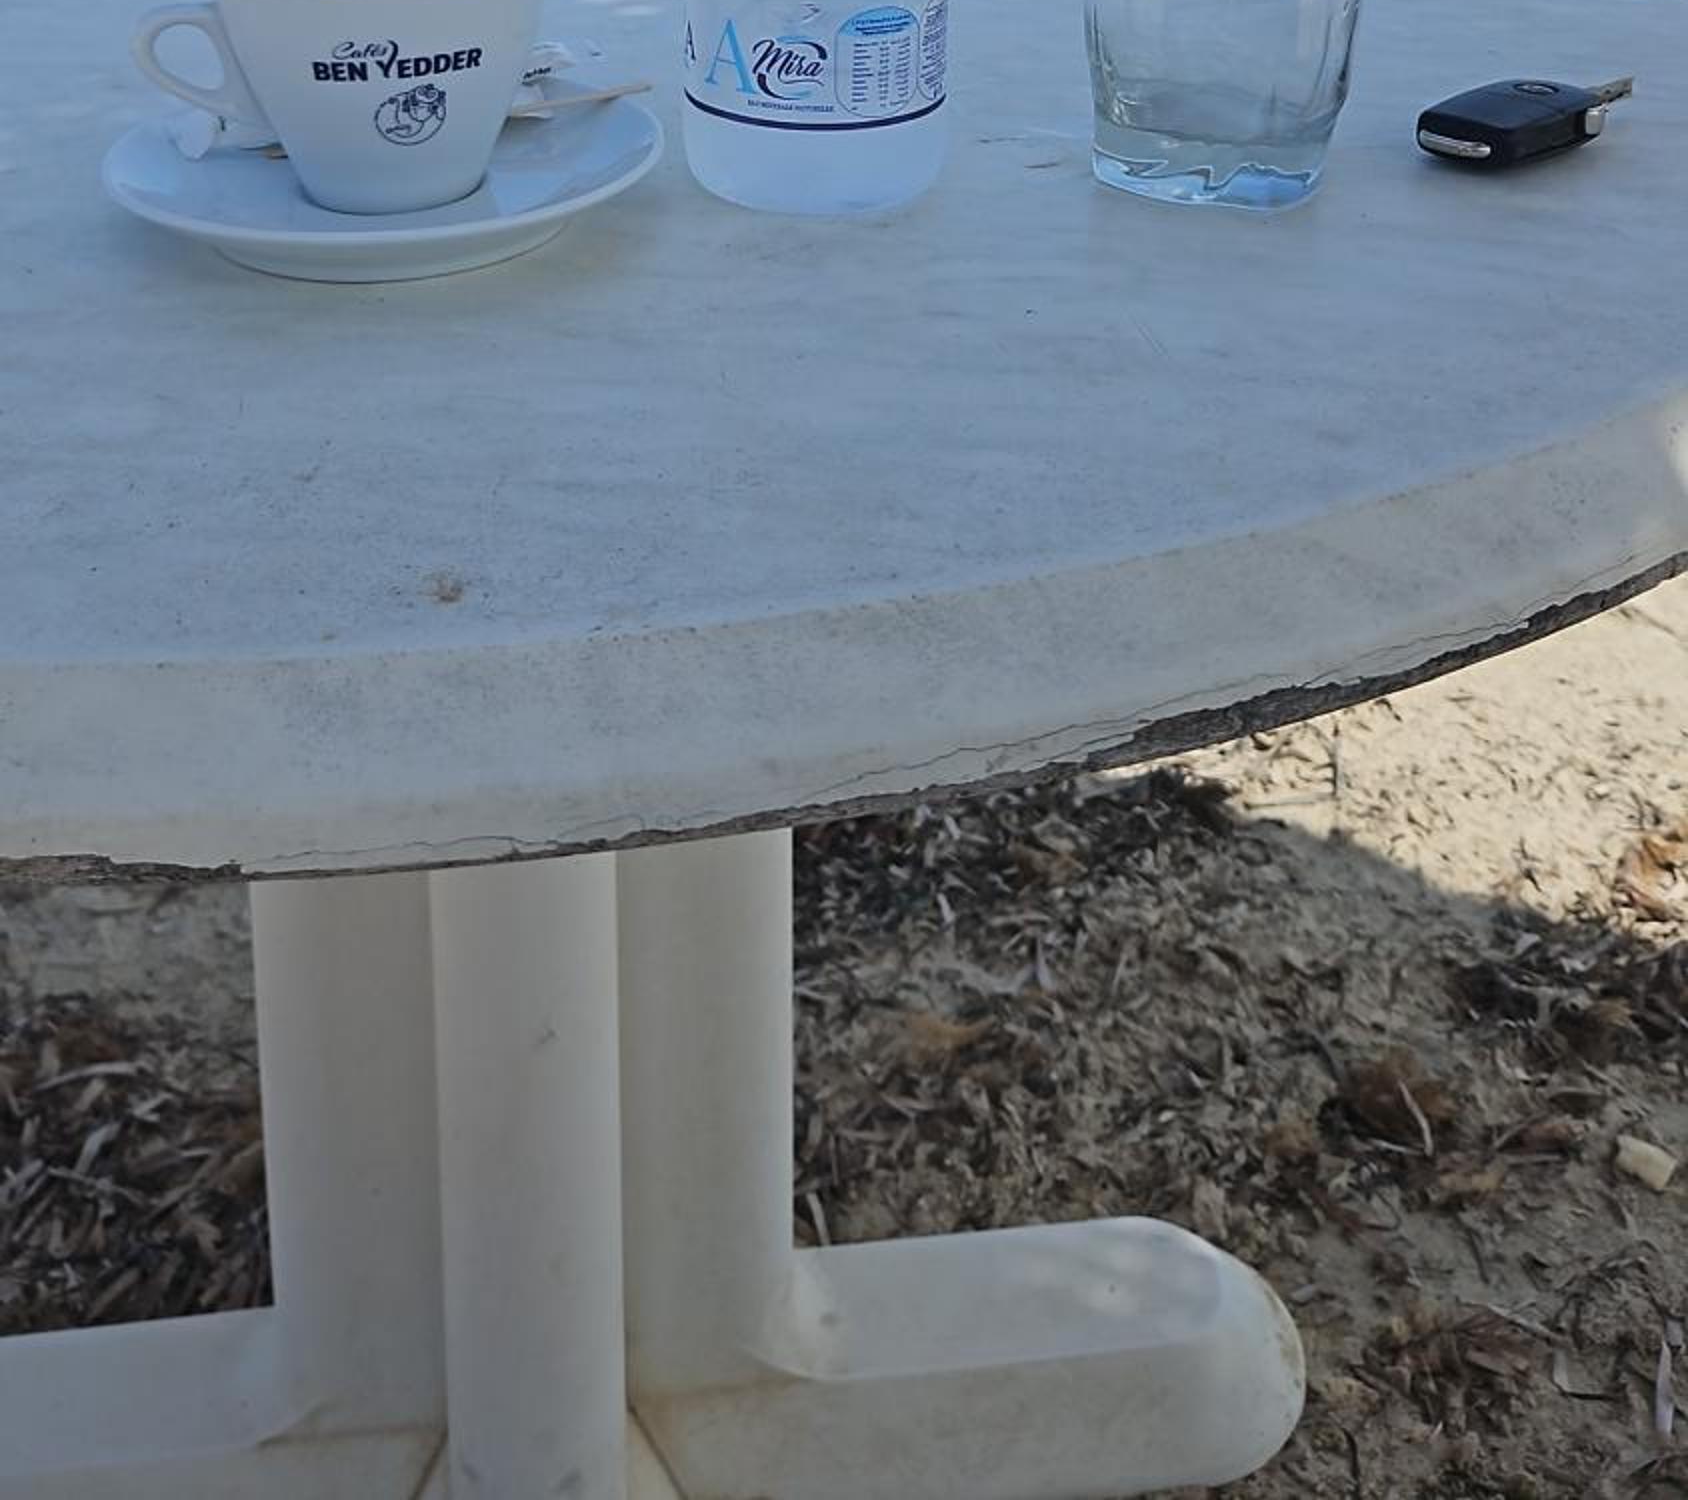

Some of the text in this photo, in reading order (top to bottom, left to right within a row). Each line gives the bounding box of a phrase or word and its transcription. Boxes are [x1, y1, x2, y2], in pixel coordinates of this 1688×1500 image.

[312, 39, 483, 82] BEN YEDDER
[752, 38, 825, 87] Mira
